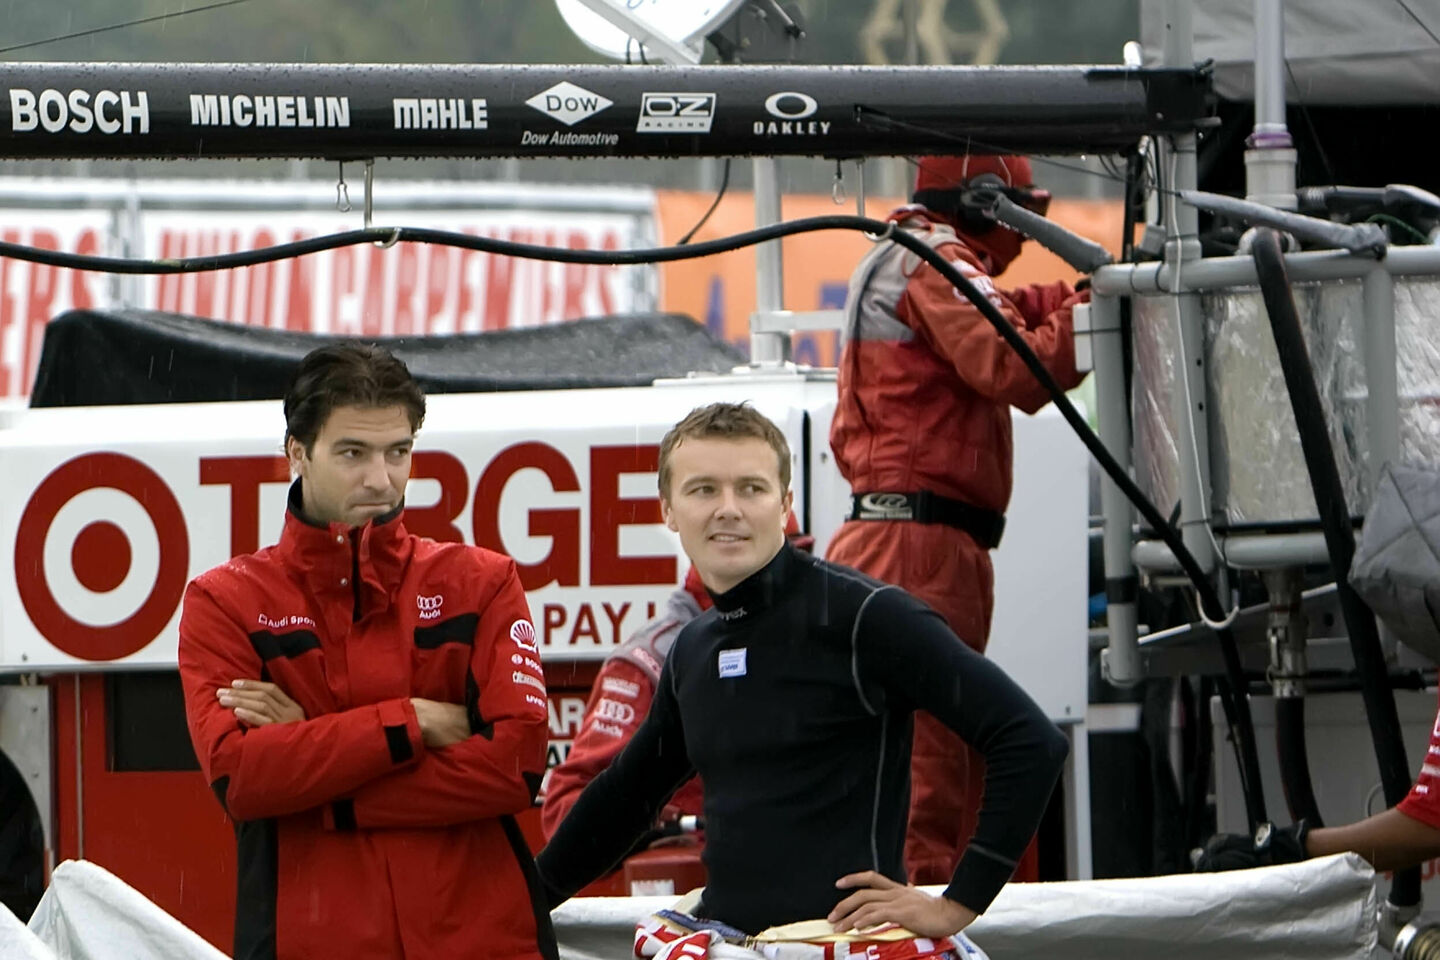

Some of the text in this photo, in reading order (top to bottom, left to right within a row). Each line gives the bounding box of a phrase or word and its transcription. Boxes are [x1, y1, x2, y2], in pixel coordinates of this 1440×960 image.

[9, 89, 149, 134] BOSCH
[190, 94, 350, 127] MICHELIN
[393, 98, 488, 130] MAHLE
[521, 131, 619, 146] Dow Automotive
[754, 121, 831, 136] OAKLEY
[268, 616, 289, 628] Audi
[420, 610, 441, 619] Audi
[543, 602, 632, 645] PAY
